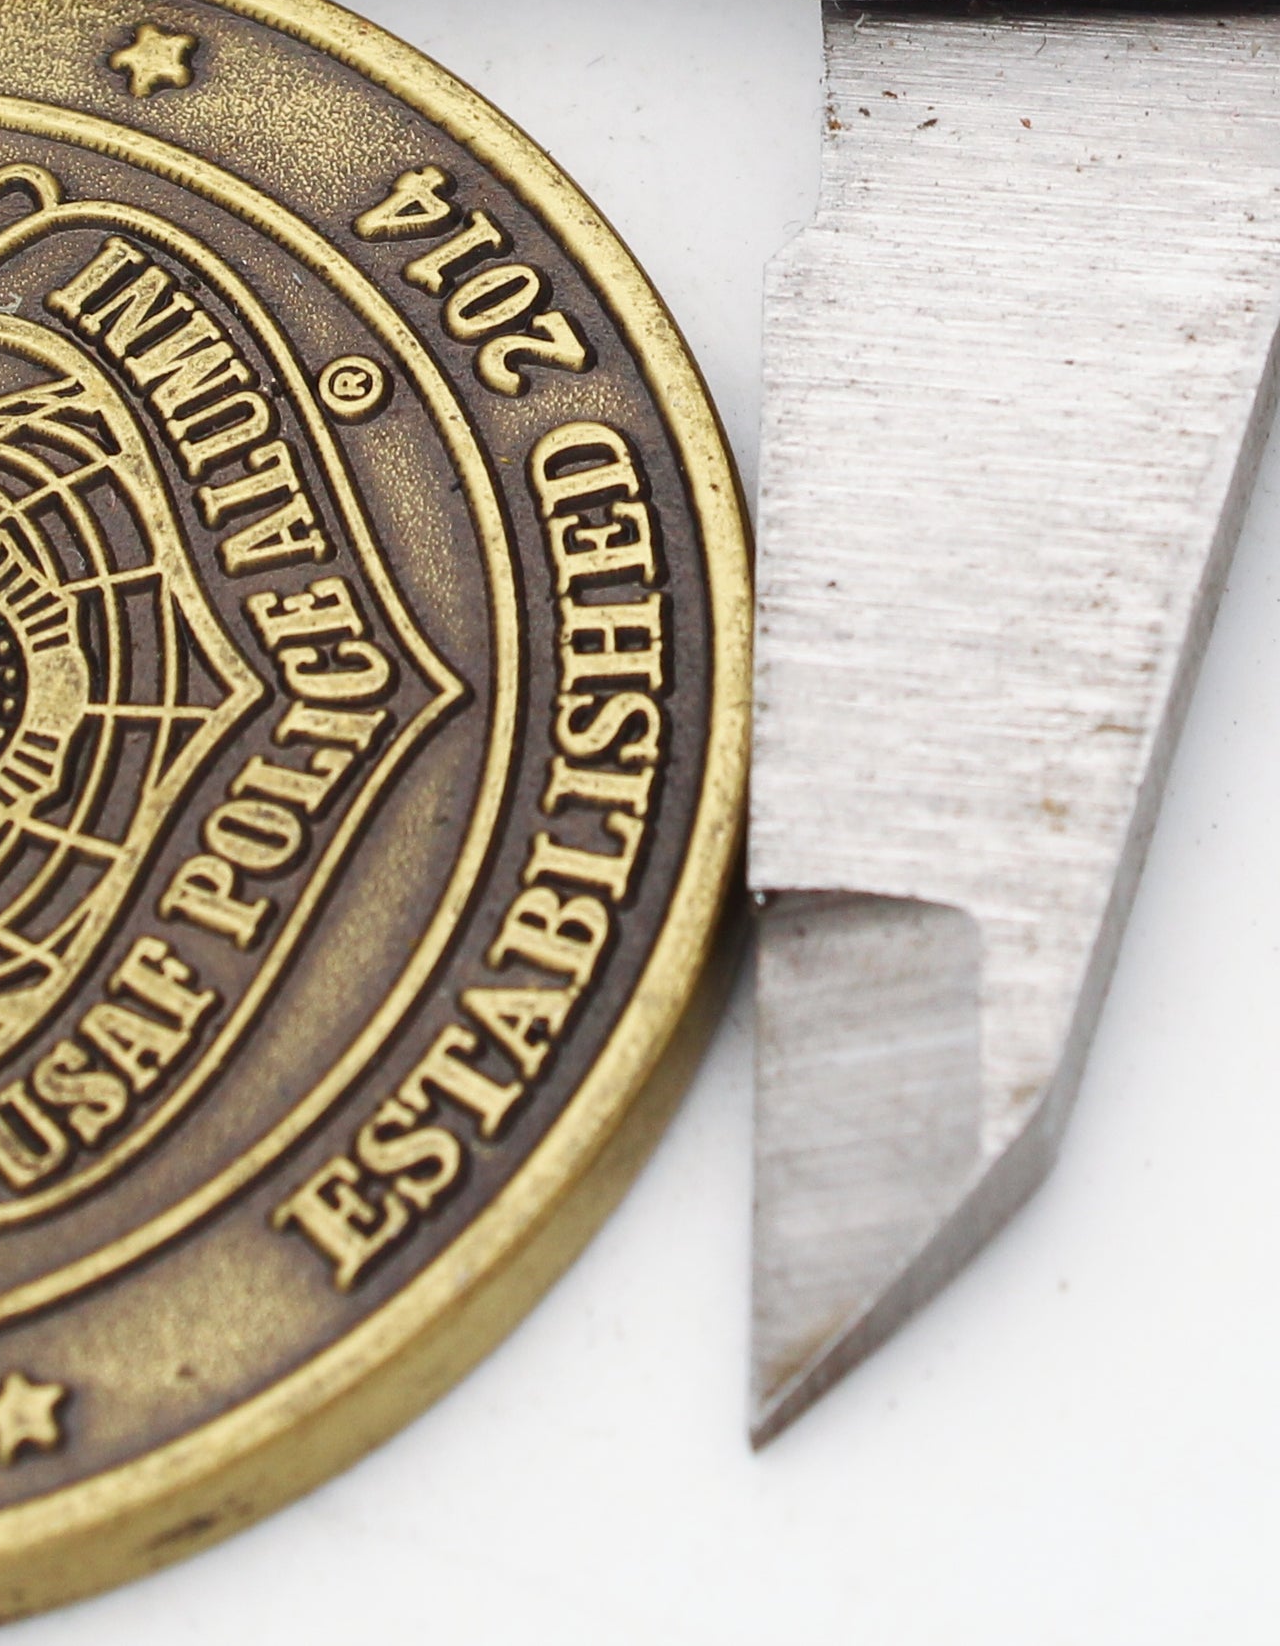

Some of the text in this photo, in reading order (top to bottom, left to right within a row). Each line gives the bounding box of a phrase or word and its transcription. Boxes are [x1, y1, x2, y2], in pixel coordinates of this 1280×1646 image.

[43, 236, 335, 576] ALUMNI
[159, 577, 393, 948] POLICE
[273, 164, 668, 1290] ESTABLISHED 2014
